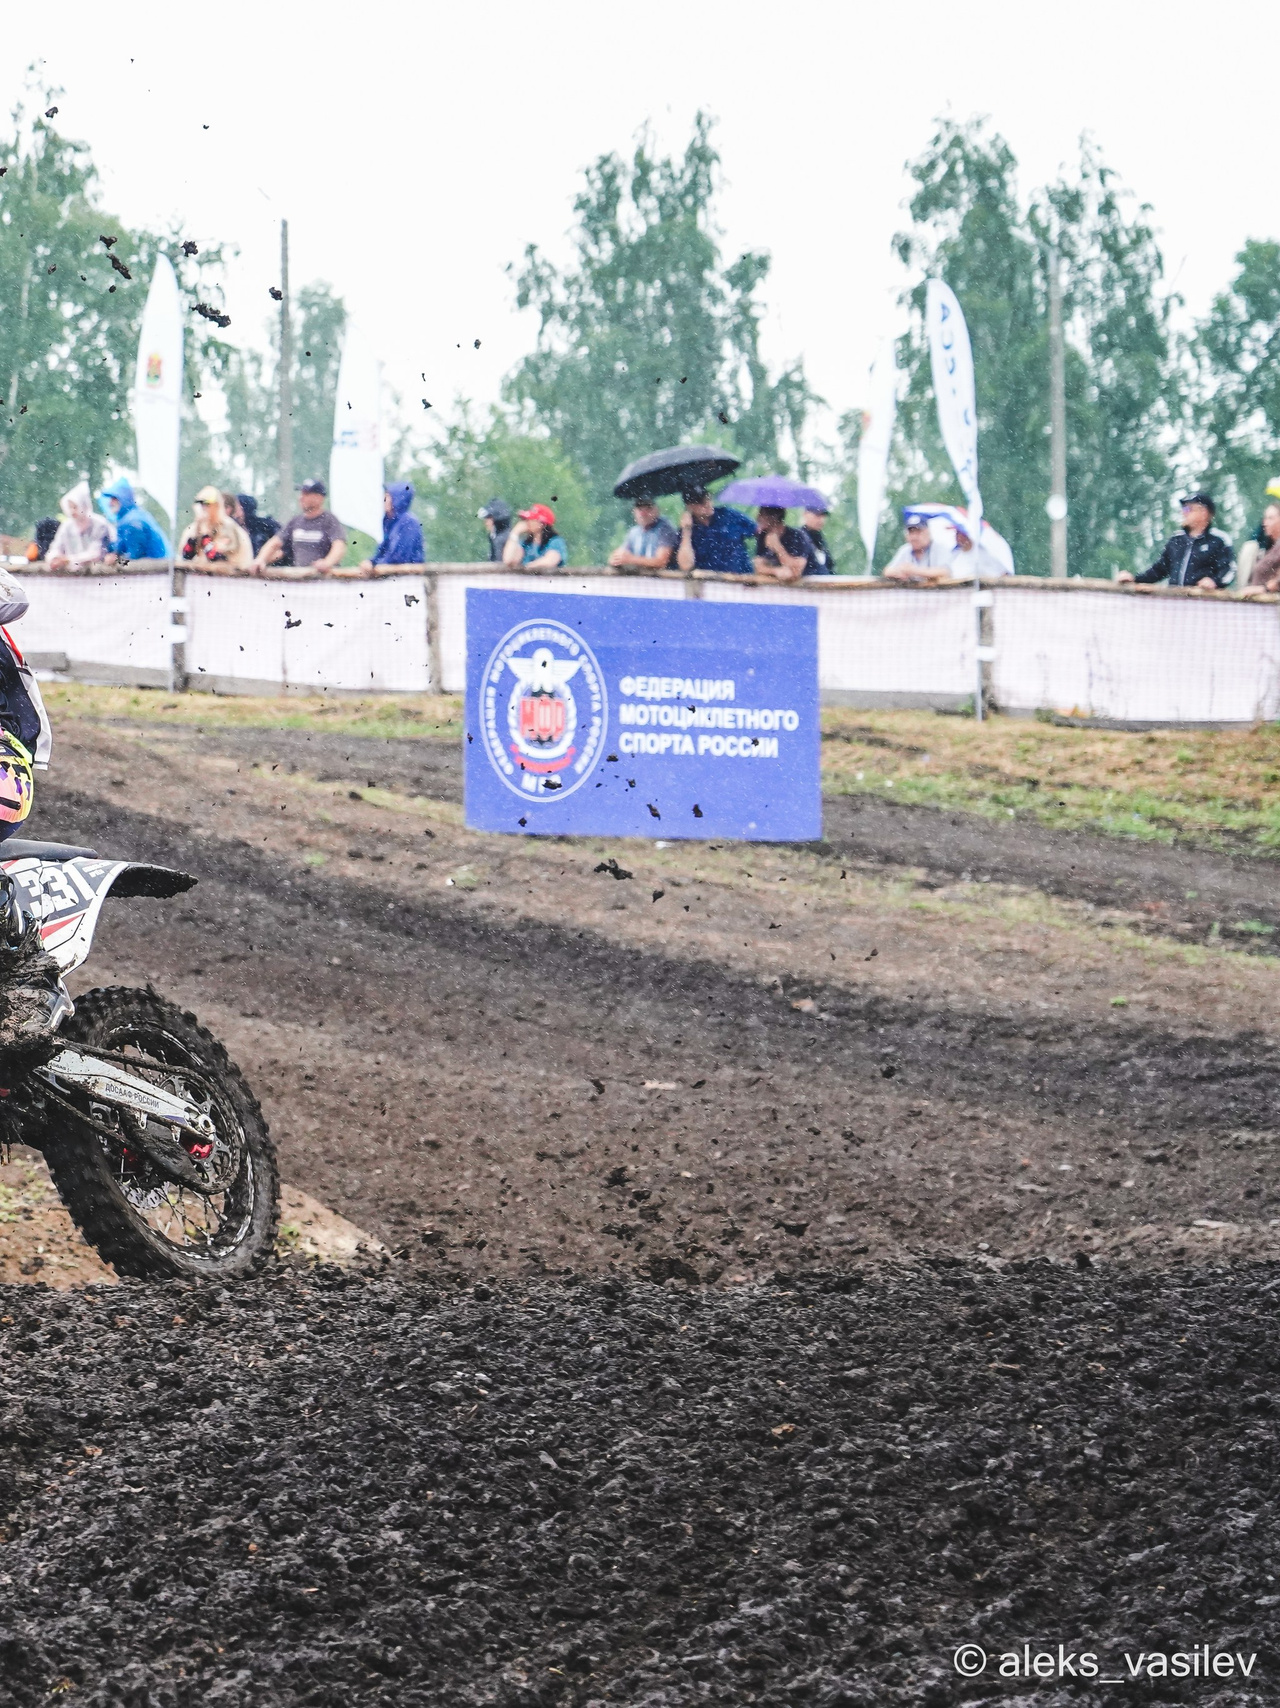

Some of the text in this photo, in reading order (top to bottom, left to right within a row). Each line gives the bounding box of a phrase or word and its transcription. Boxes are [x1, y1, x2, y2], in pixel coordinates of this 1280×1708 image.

[620, 676, 735, 702] ФЕДЕРАЦИЯ
[620, 703, 799, 731] МОТОЦИКЛЕТНОГО
[619, 732, 779, 758] СПОРТА РОССИИ
[15, 863, 94, 919] 331
